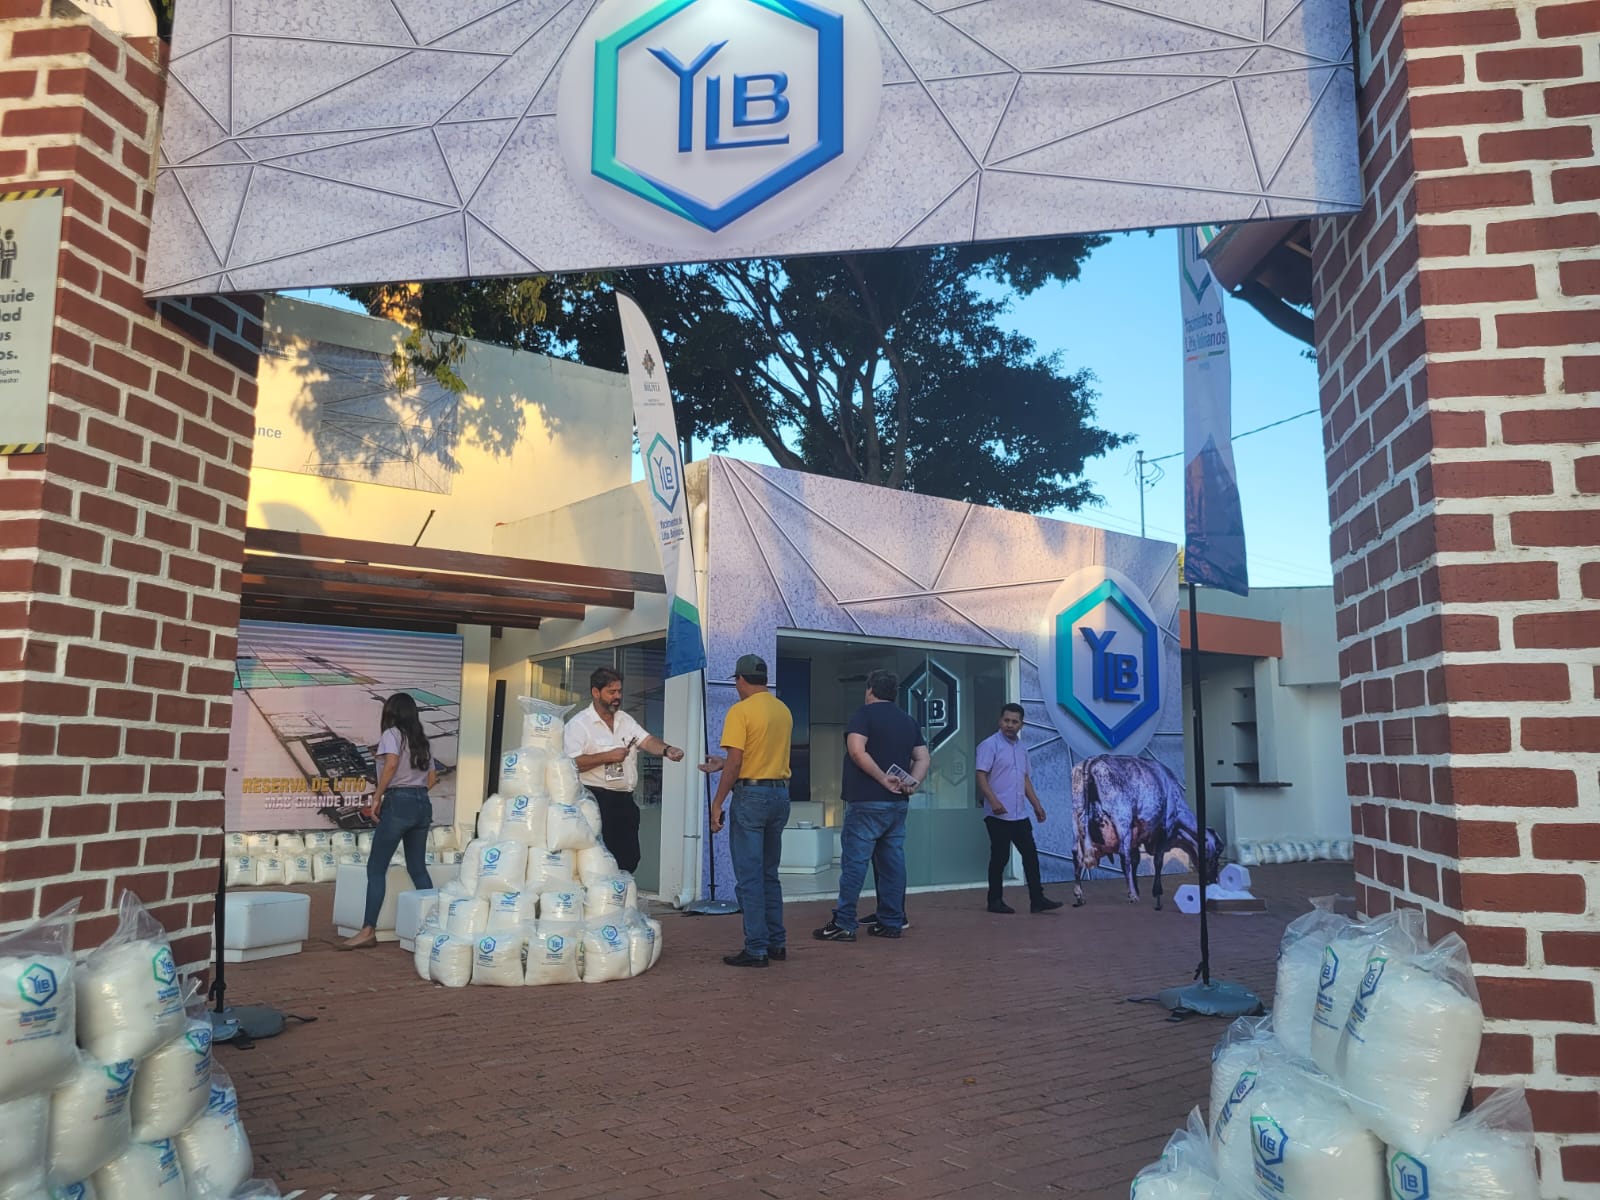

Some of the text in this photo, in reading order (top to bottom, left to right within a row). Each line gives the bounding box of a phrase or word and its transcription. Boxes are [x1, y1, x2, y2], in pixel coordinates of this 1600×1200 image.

[646, 39, 790, 153] YLB
[653, 456, 675, 490] YLB
[1079, 626, 1141, 702] YLB
[311, 777, 330, 792] DE
[27, 975, 51, 994] YLB
[1258, 1124, 1276, 1155] YLB
[1395, 1163, 1419, 1193] YLB
